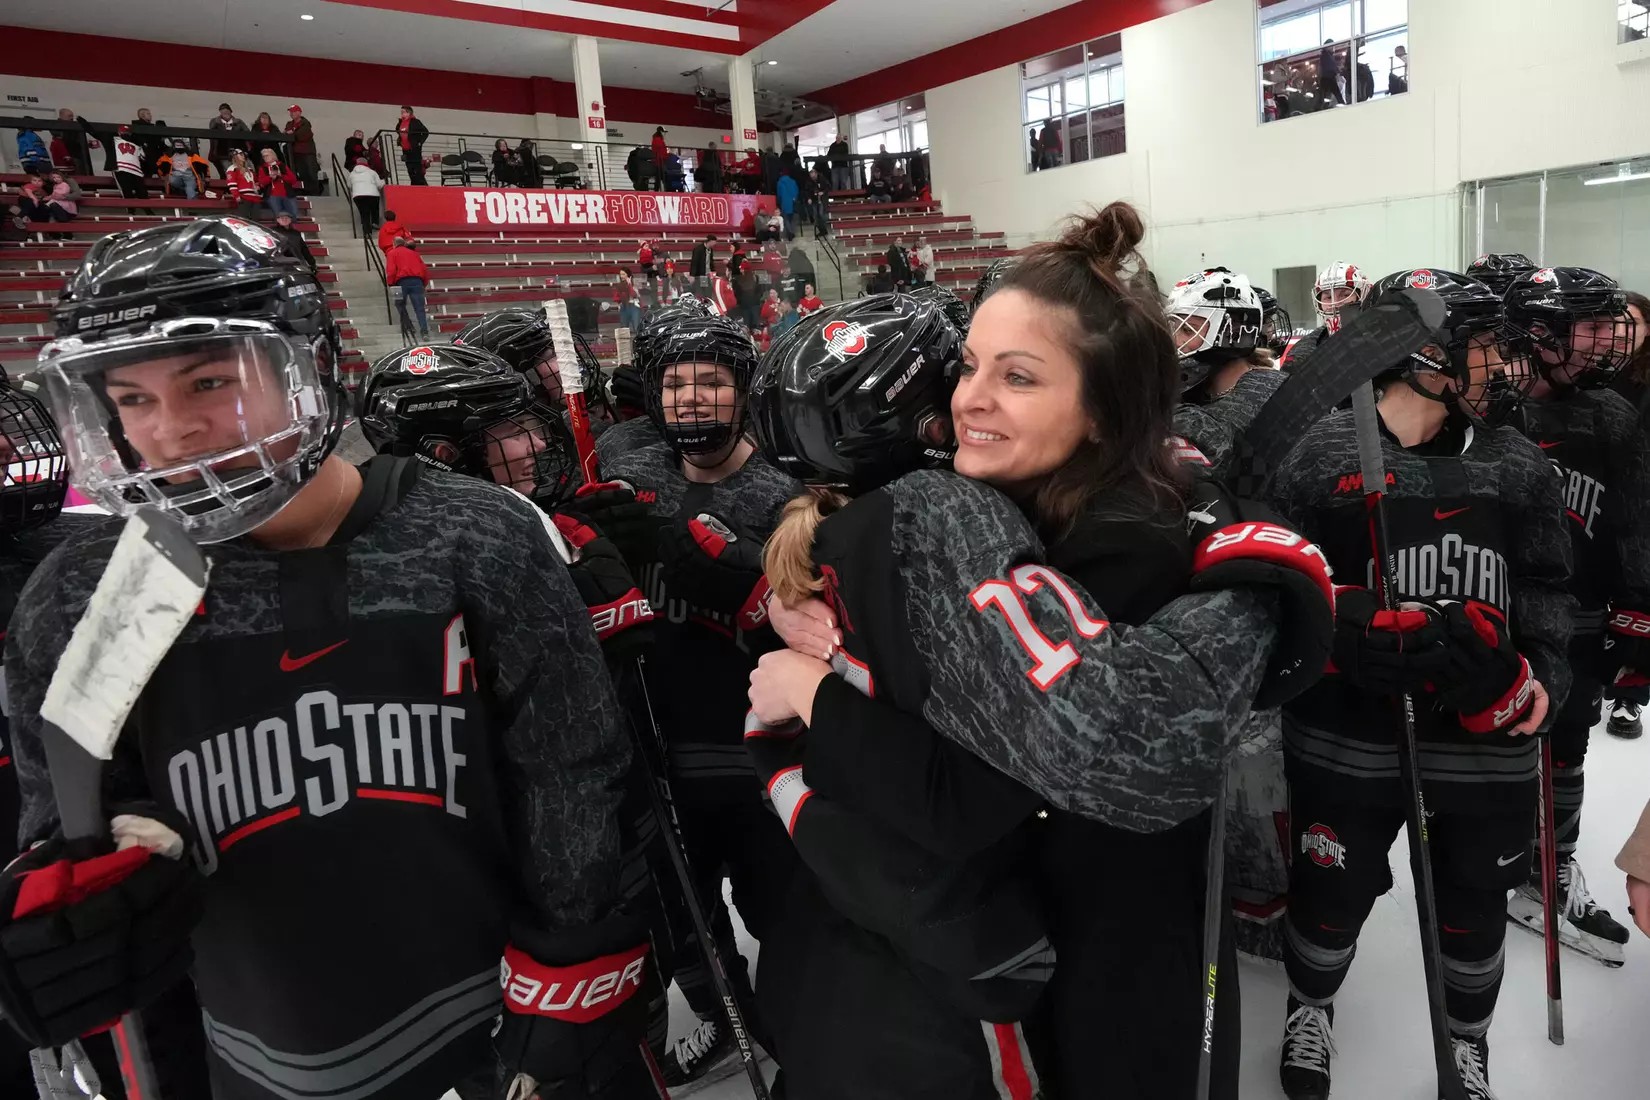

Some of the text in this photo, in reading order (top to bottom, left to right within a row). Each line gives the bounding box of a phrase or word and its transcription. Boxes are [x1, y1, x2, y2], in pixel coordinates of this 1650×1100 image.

[77, 304, 157, 330] BAUER
[672, 331, 708, 340] BAUER
[1410, 352, 1443, 370] BAUER
[885, 354, 926, 402] BAUER
[407, 399, 459, 413] BAUER
[924, 448, 955, 460] BAU
[500, 955, 645, 1011] BAUER
[1203, 963, 1217, 1053] HYPERLITE
[723, 995, 751, 1050] BAUER
